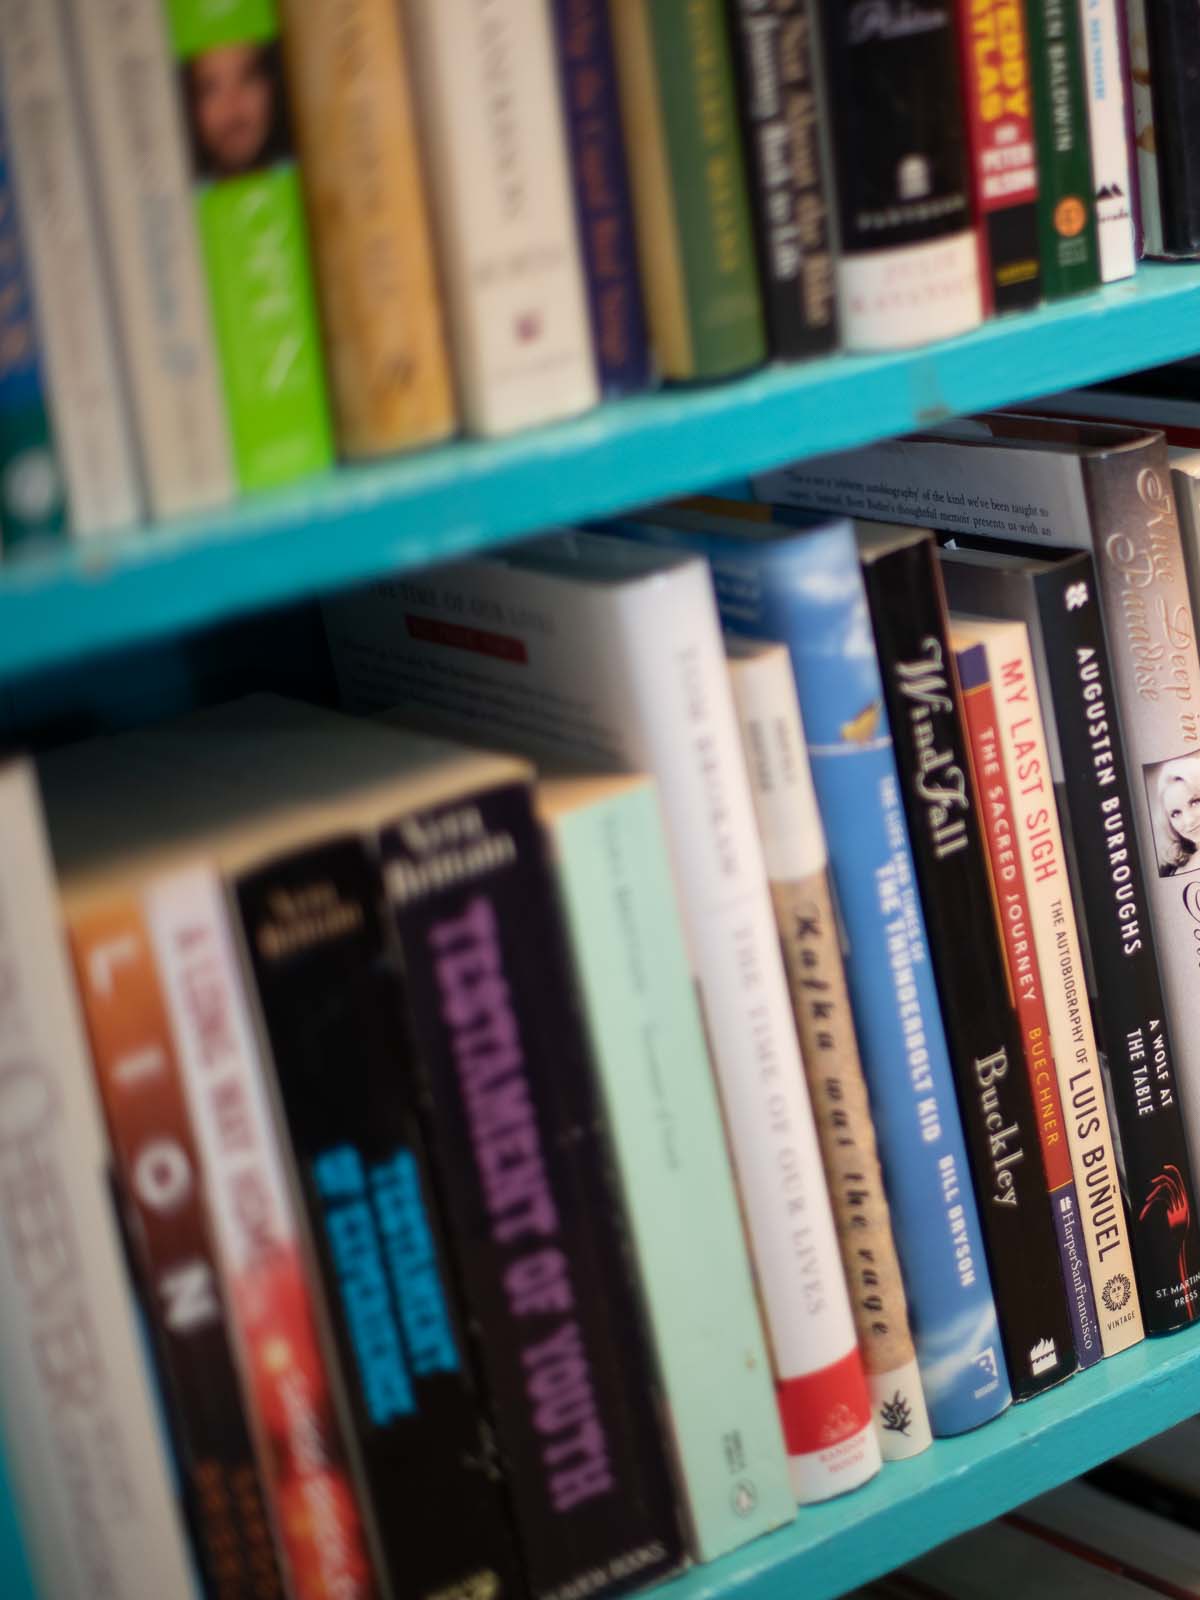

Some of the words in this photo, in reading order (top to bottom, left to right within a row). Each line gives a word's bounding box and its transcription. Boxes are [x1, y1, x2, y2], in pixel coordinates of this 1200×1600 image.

[1049, 44, 1072, 151] BALDWIN
[939, 510, 970, 524] memoir
[972, 516, 1006, 531] presents
[1020, 521, 1039, 535] with
[967, 495, 990, 511] we've
[991, 498, 1010, 513] been
[1012, 503, 1039, 519] taught
[1105, 531, 1164, 702] Paradise
[1000, 658, 1029, 706] MY
[979, 727, 1000, 777] THE
[1011, 718, 1045, 795] LAST
[1180, 710, 1199, 742] in
[985, 786, 1016, 882] SACRED
[1076, 646, 1117, 787] AUGUSTEN
[1100, 794, 1143, 955] BURROUGHS
[1026, 813, 1058, 884] SIGH
[875, 860, 902, 916] THE
[1048, 900, 1065, 930] THE
[1005, 894, 1038, 1001] JOURNEY
[886, 919, 934, 1092] THUNDERBOLT
[1055, 930, 1087, 1044] AUTOBIOGRAPHY
[1075, 1046, 1089, 1065] OF
[1126, 1026, 1144, 1065] THE
[1148, 1019, 1159, 1032] A
[1151, 1036, 1169, 1084] WOLF
[427, 893, 557, 1242] TESTAMENT
[1028, 1027, 1060, 1147] BUECHNER
[1132, 1068, 1155, 1117] TABLE
[1159, 1087, 1174, 1108] AT
[823, 1076, 857, 1147] was
[917, 1097, 942, 1142] KID
[975, 1046, 1025, 1206] Buckley
[1068, 1069, 1101, 1146] LUIS
[843, 1171, 873, 1229] the
[937, 1154, 961, 1203] BILL
[1081, 1144, 1123, 1264] BUÑUEL
[503, 1248, 575, 1315] OF
[793, 1224, 827, 1316] LIVES
[947, 1204, 976, 1288] BRYSON
[1061, 1210, 1094, 1350] HarperSanFrancisco
[857, 1247, 889, 1337] rage
[1107, 1311, 1136, 1331] VINTAGE
[1173, 1289, 1199, 1308] PRESS
[522, 1320, 613, 1512] YOUTH
